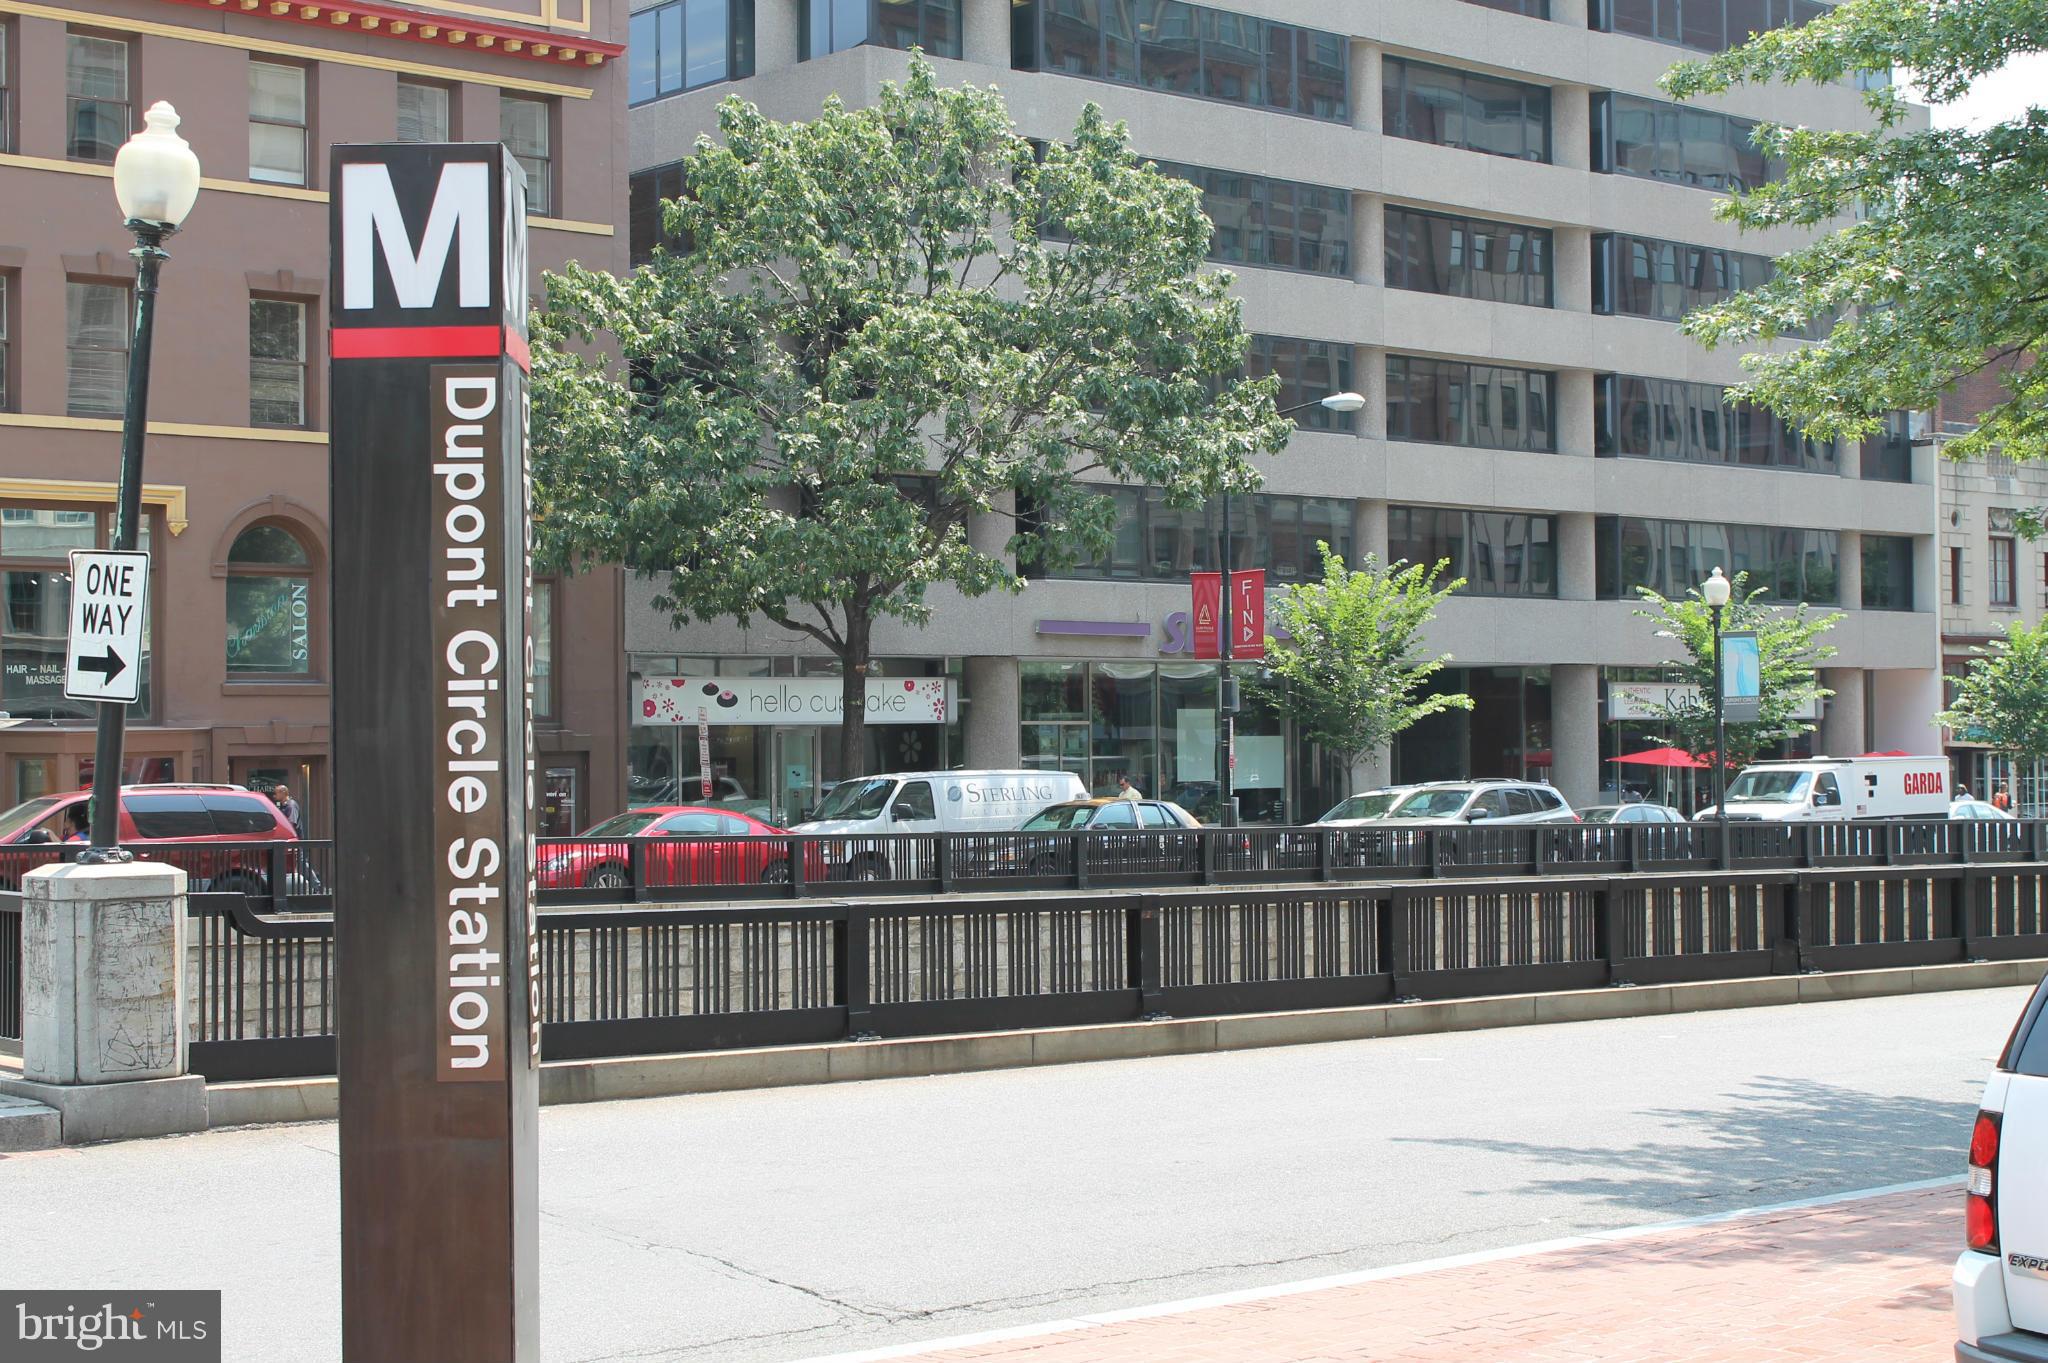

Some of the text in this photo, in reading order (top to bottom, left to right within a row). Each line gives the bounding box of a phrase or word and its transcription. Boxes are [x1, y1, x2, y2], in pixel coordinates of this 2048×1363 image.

[342, 162, 490, 309] M
[87, 563, 134, 597] ONE
[83, 603, 133, 636] WAY
[291, 583, 308, 661] SALON
[6, 664, 28, 674] HAIR
[40, 664, 60, 674] NAIL
[25, 675, 66, 685] MASSAGE
[750, 683, 906, 715] hello cupake
[433, 377, 500, 1069] Dupont Circle Station
[522, 391, 541, 1056] Dupont Circle Station
[966, 783, 1052, 803] STERLING
[1904, 771, 1943, 796] GARDA
[2009, 1254, 2048, 1272] EXPL
